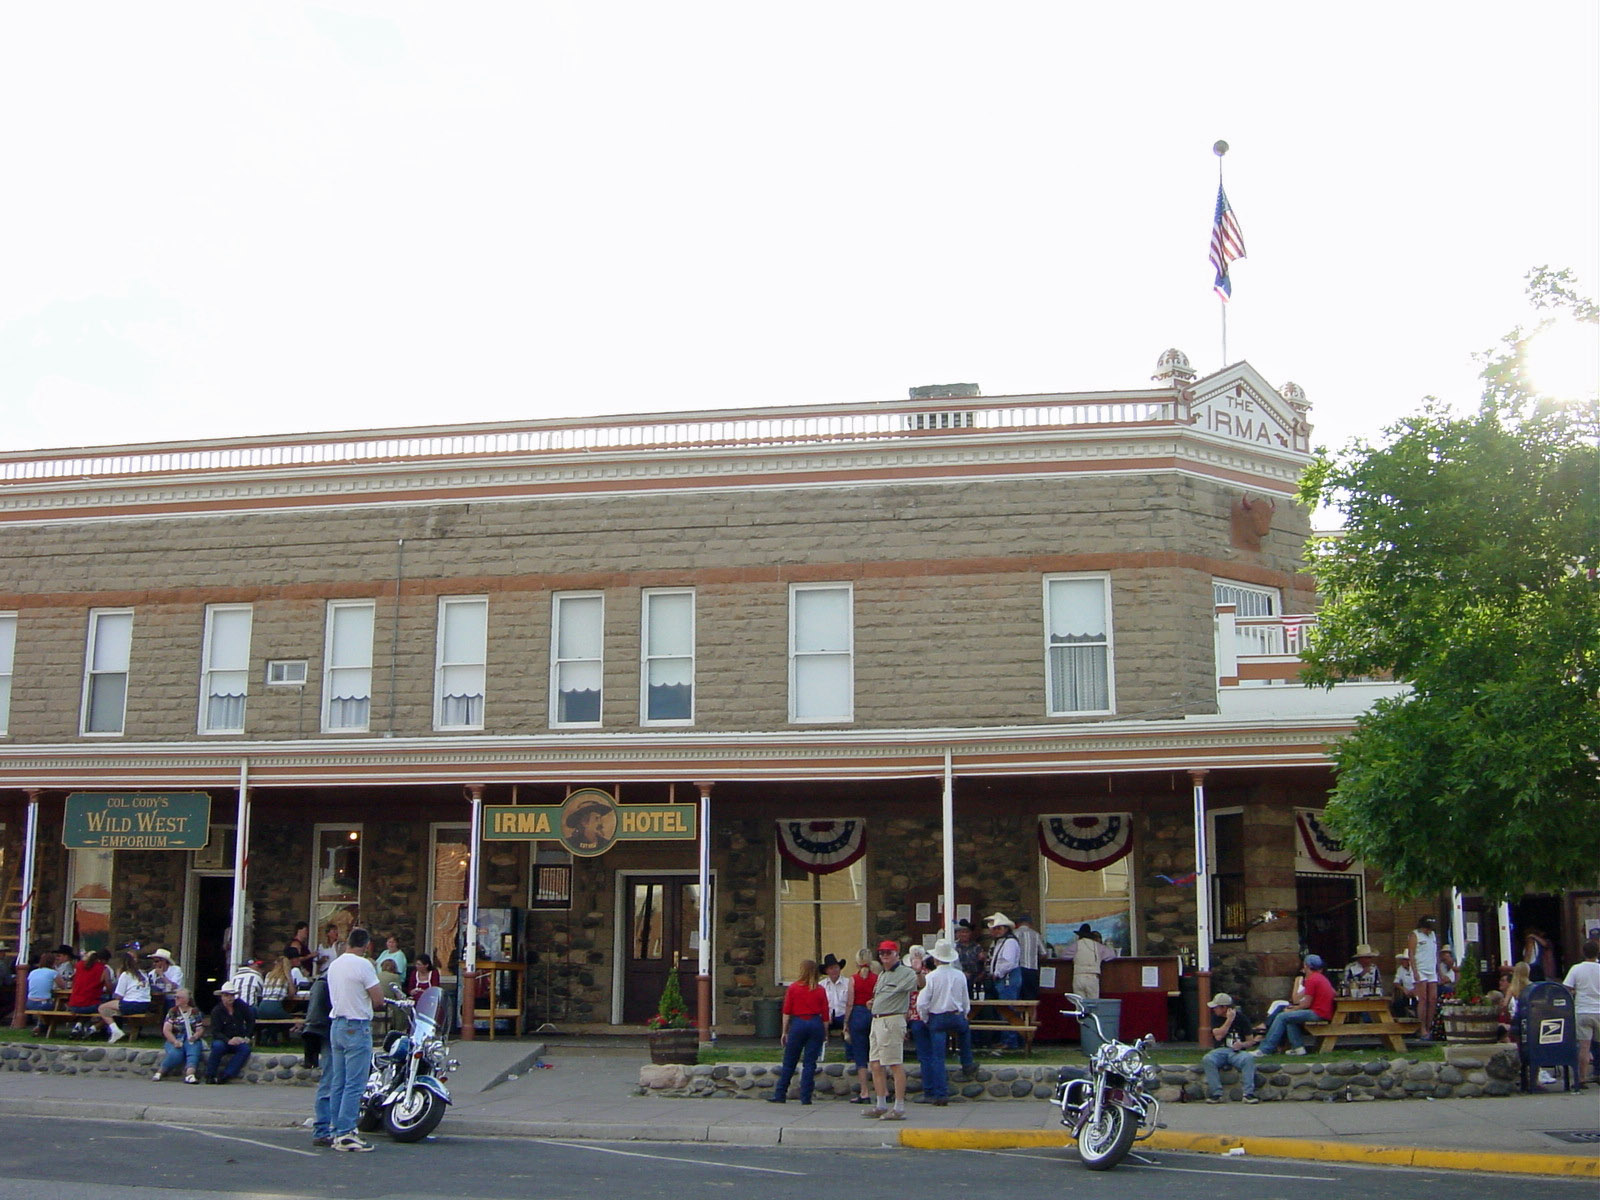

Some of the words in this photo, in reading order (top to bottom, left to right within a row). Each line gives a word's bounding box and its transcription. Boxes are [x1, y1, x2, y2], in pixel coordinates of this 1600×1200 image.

[1225, 395, 1254, 413] THE
[1207, 404, 1272, 445] IRMA
[132, 796, 169, 808] CODY'S
[86, 808, 132, 833] WILD
[135, 808, 188, 833] WEST
[494, 812, 552, 834] IRMA
[622, 811, 688, 833] HOTEL
[101, 835, 168, 848] EMPORIUM
